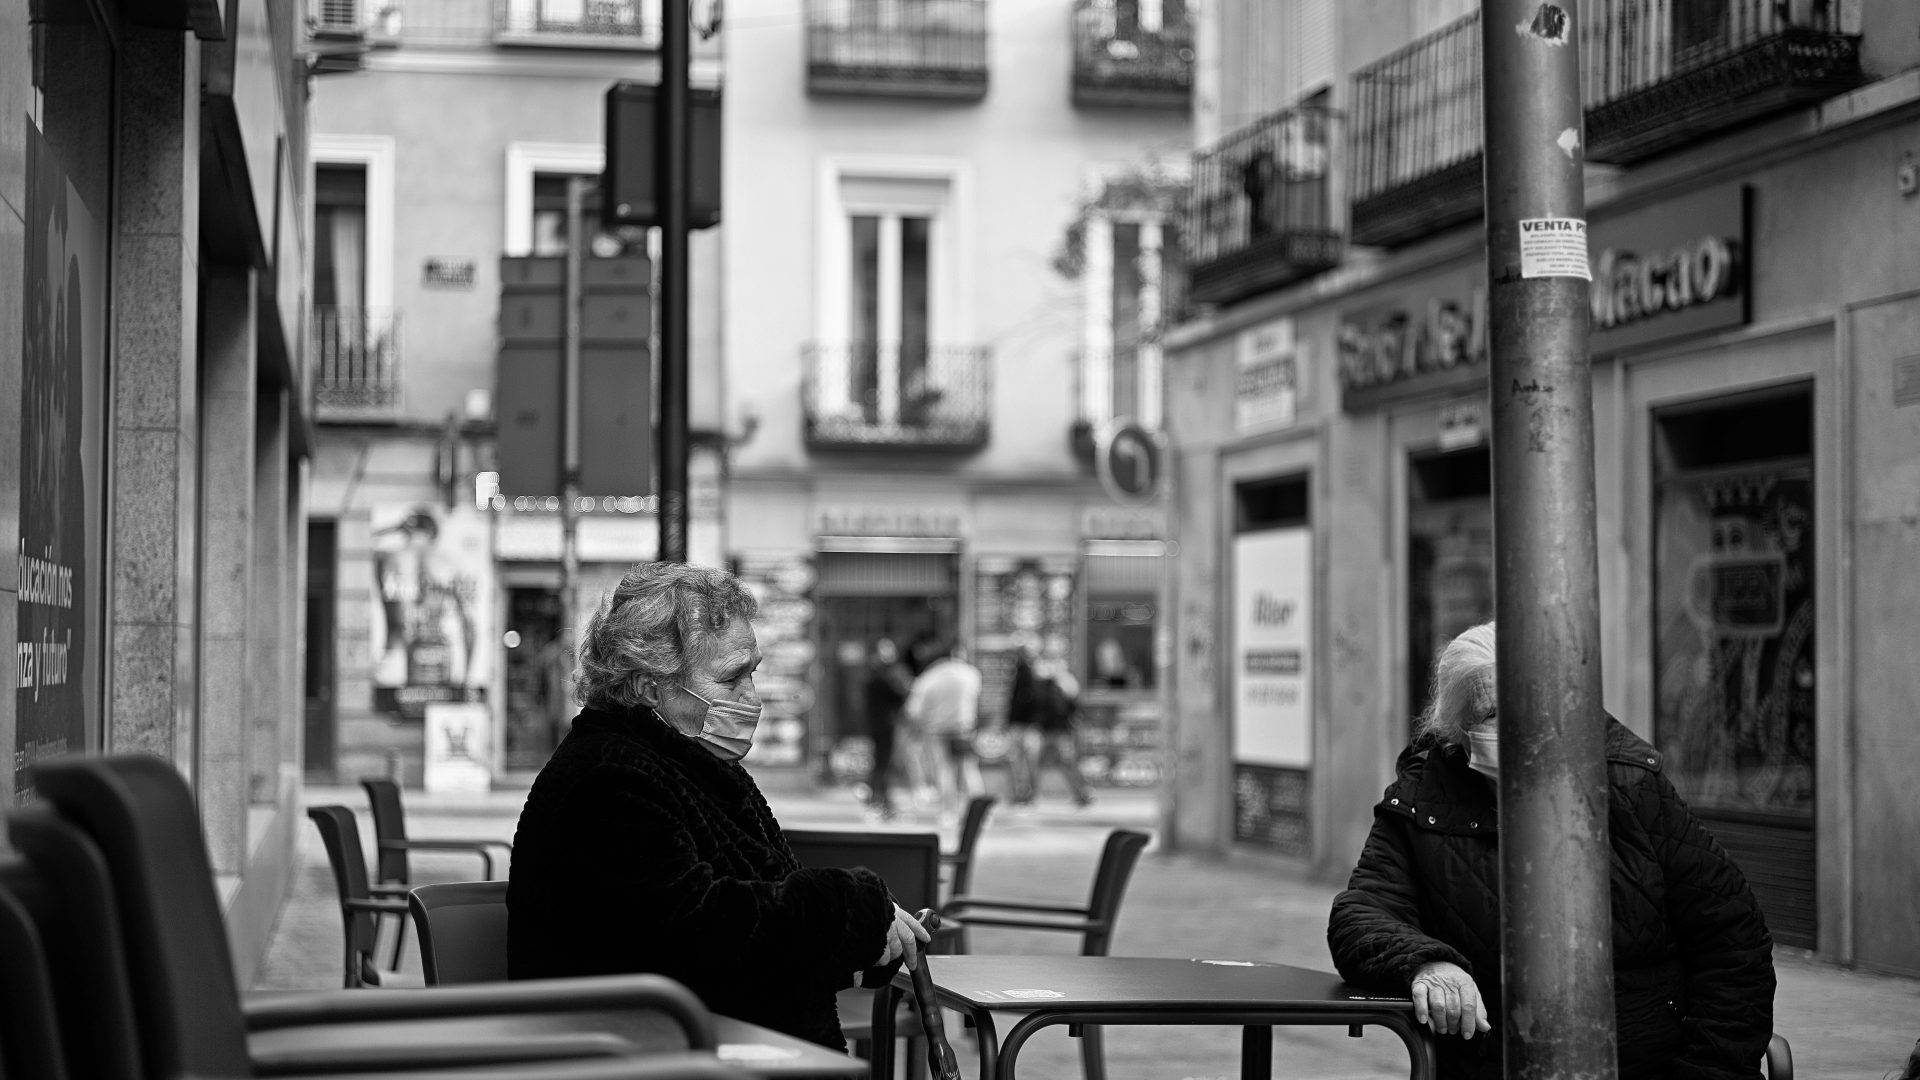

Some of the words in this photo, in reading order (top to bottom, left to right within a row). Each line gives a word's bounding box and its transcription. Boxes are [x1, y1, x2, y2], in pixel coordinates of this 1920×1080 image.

[1522, 221, 1572, 232] VENTA
[1576, 222, 1586, 232] P
[58, 565, 73, 608] nos
[17, 642, 33, 688] nza
[35, 642, 42, 702] y
